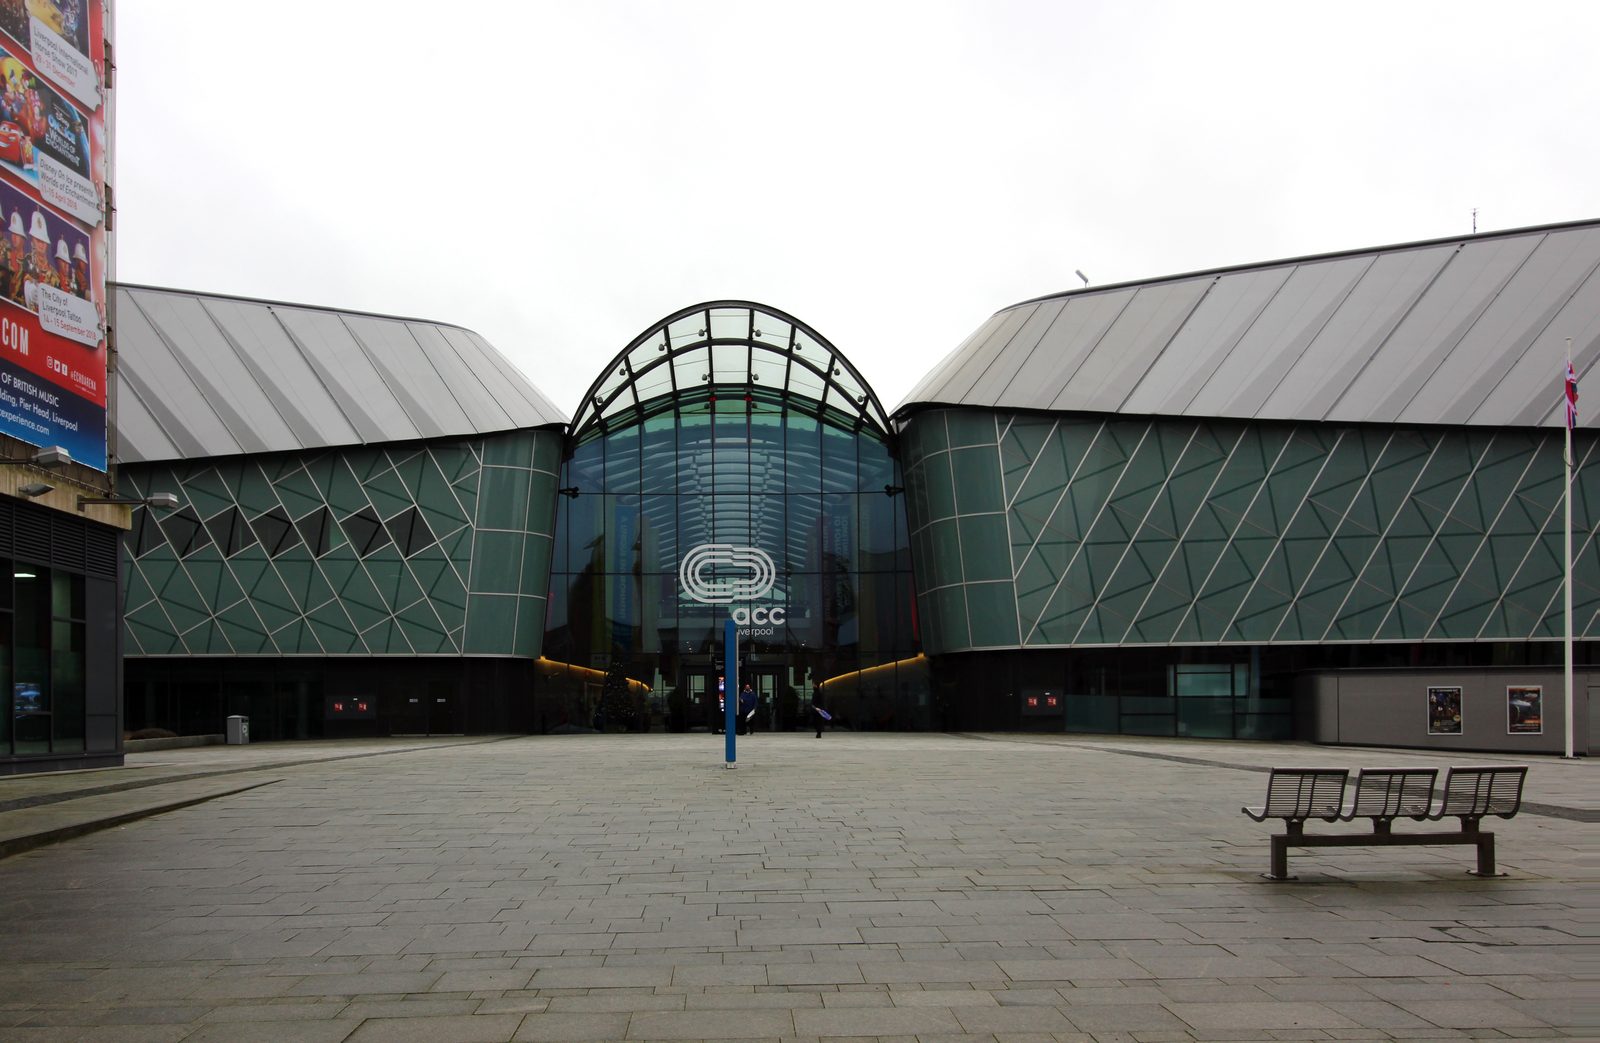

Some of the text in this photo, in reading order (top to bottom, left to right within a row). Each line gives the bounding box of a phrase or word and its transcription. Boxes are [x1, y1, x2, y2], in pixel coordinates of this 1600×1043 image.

[40, 158, 57, 177] Disney
[41, 172, 58, 188] Worlds
[65, 184, 96, 209] Enchantment
[41, 288, 68, 306] The City of
[42, 301, 82, 323] Liverpool Tattoo
[2, 317, 29, 356] COM
[60, 320, 86, 336] September
[1, 372, 12, 385] OF
[13, 377, 38, 397] BRITISH
[38, 390, 60, 407] MUSIC
[19, 397, 32, 411] Pier
[33, 404, 51, 421] Head,
[52, 412, 78, 431] Liverpool
[732, 607, 786, 625] acc
